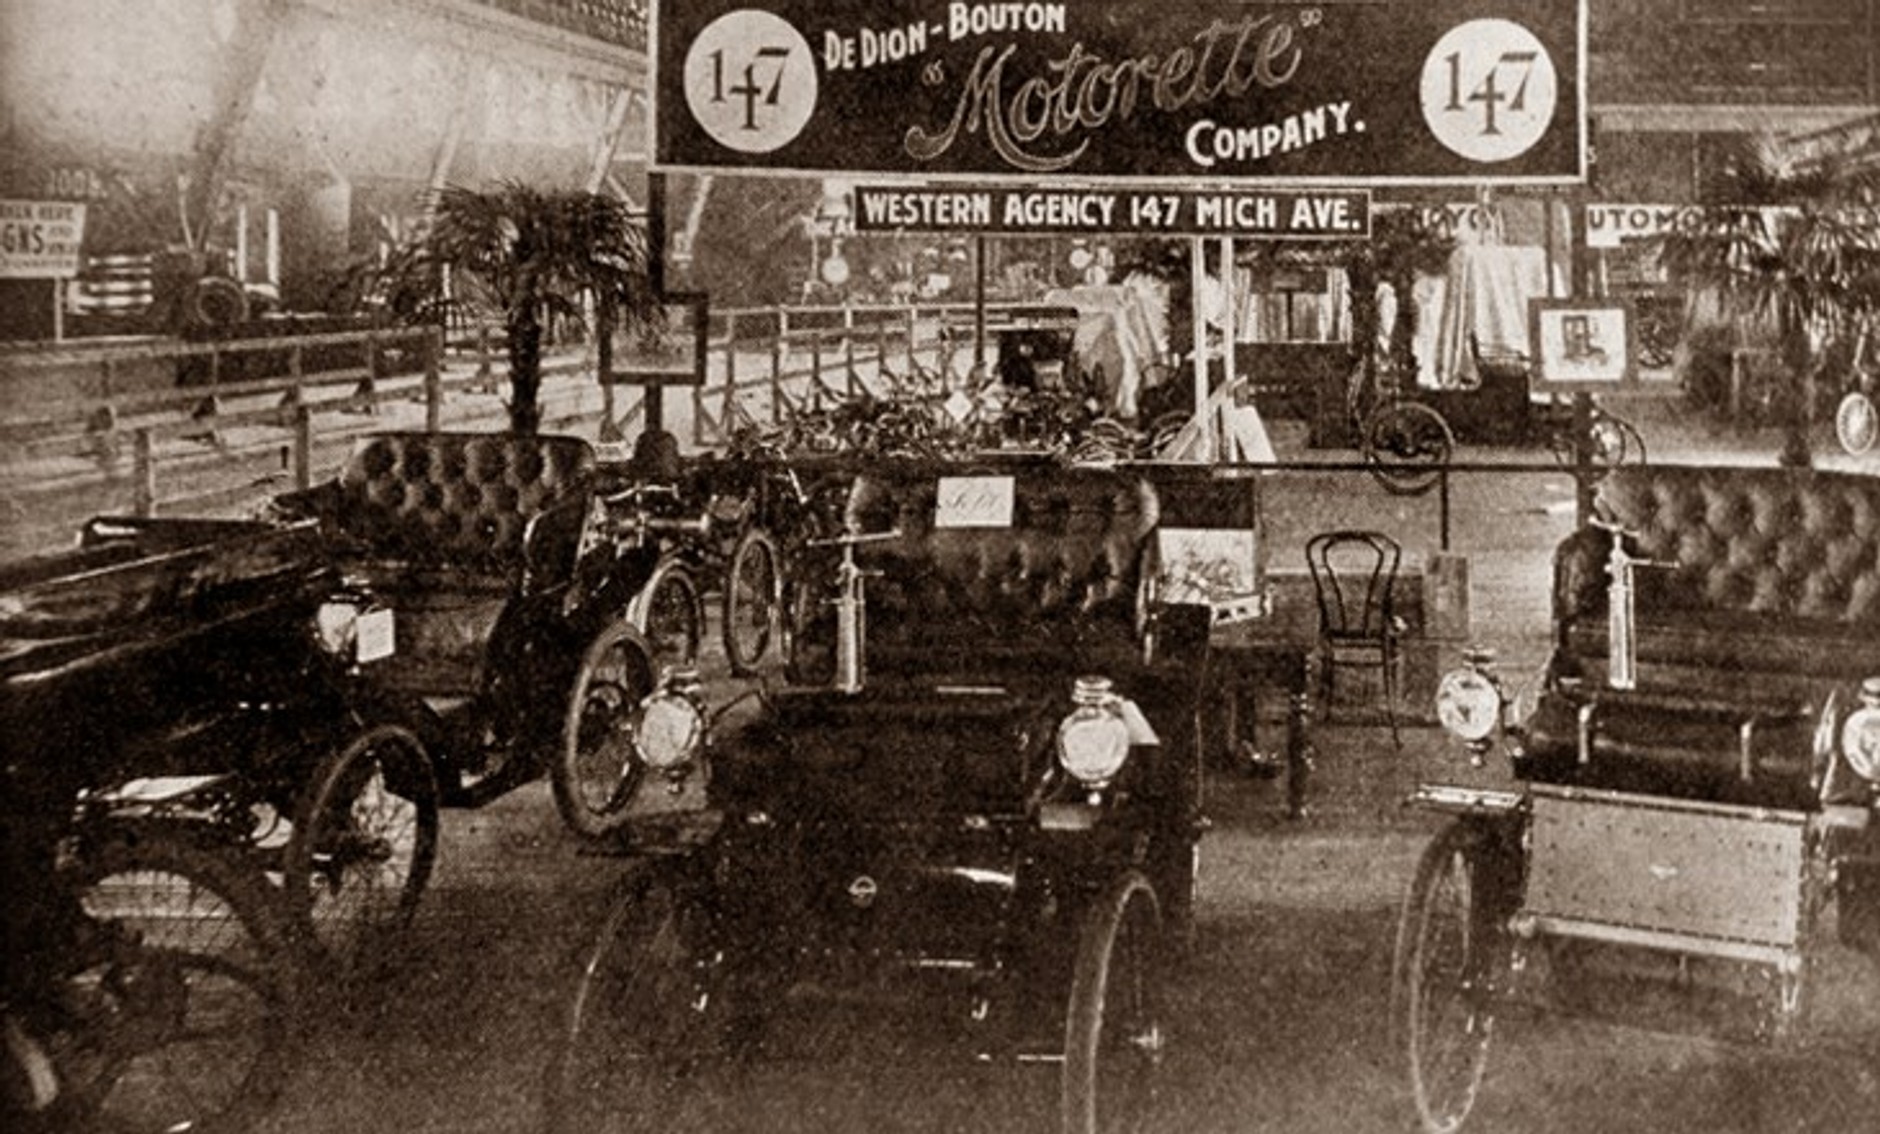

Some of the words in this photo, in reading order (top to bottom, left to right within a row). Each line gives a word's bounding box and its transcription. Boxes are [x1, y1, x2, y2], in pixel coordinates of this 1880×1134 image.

[709, 47, 791, 131] 147
[1443, 51, 1538, 135] 147
[862, 192, 992, 226] WESTERN
[1003, 193, 1117, 226] AGENCY
[1130, 195, 1181, 227] 147
[1196, 196, 1278, 228] MICH
[1290, 197, 1361, 230] AVE.
